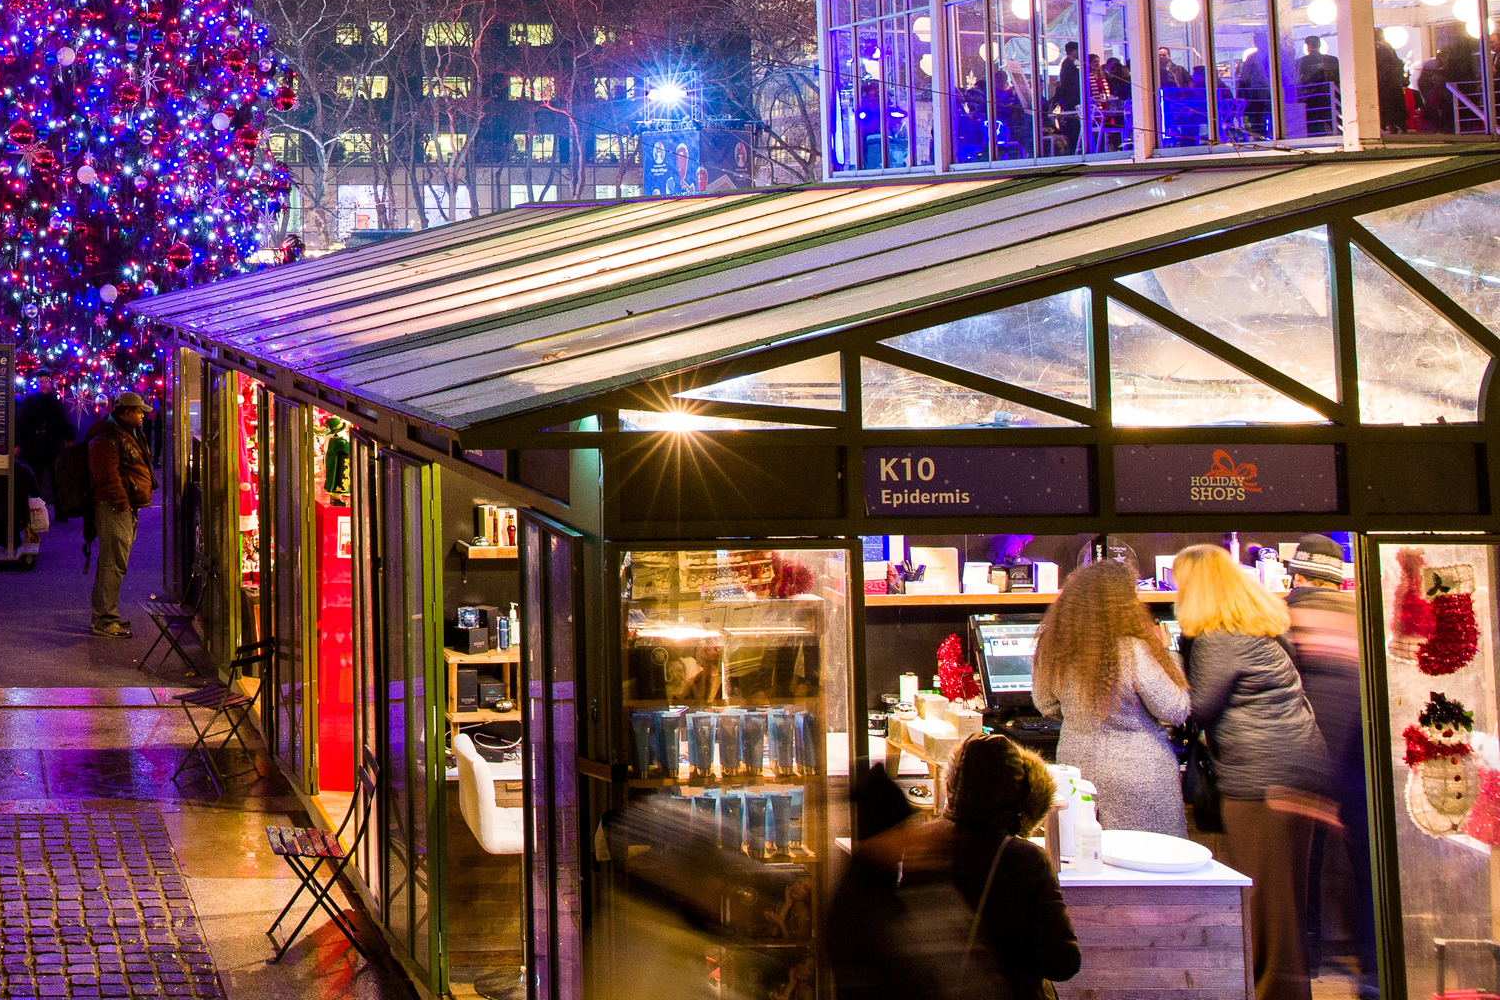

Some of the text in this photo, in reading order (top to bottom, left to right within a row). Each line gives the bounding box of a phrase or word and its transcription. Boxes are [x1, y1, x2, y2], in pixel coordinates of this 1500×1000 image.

[880, 457, 935, 481] K10
[1190, 476, 1245, 486] HOLIDAY
[881, 489, 970, 508] Epidermis
[1190, 487, 1246, 501] SHOPS
